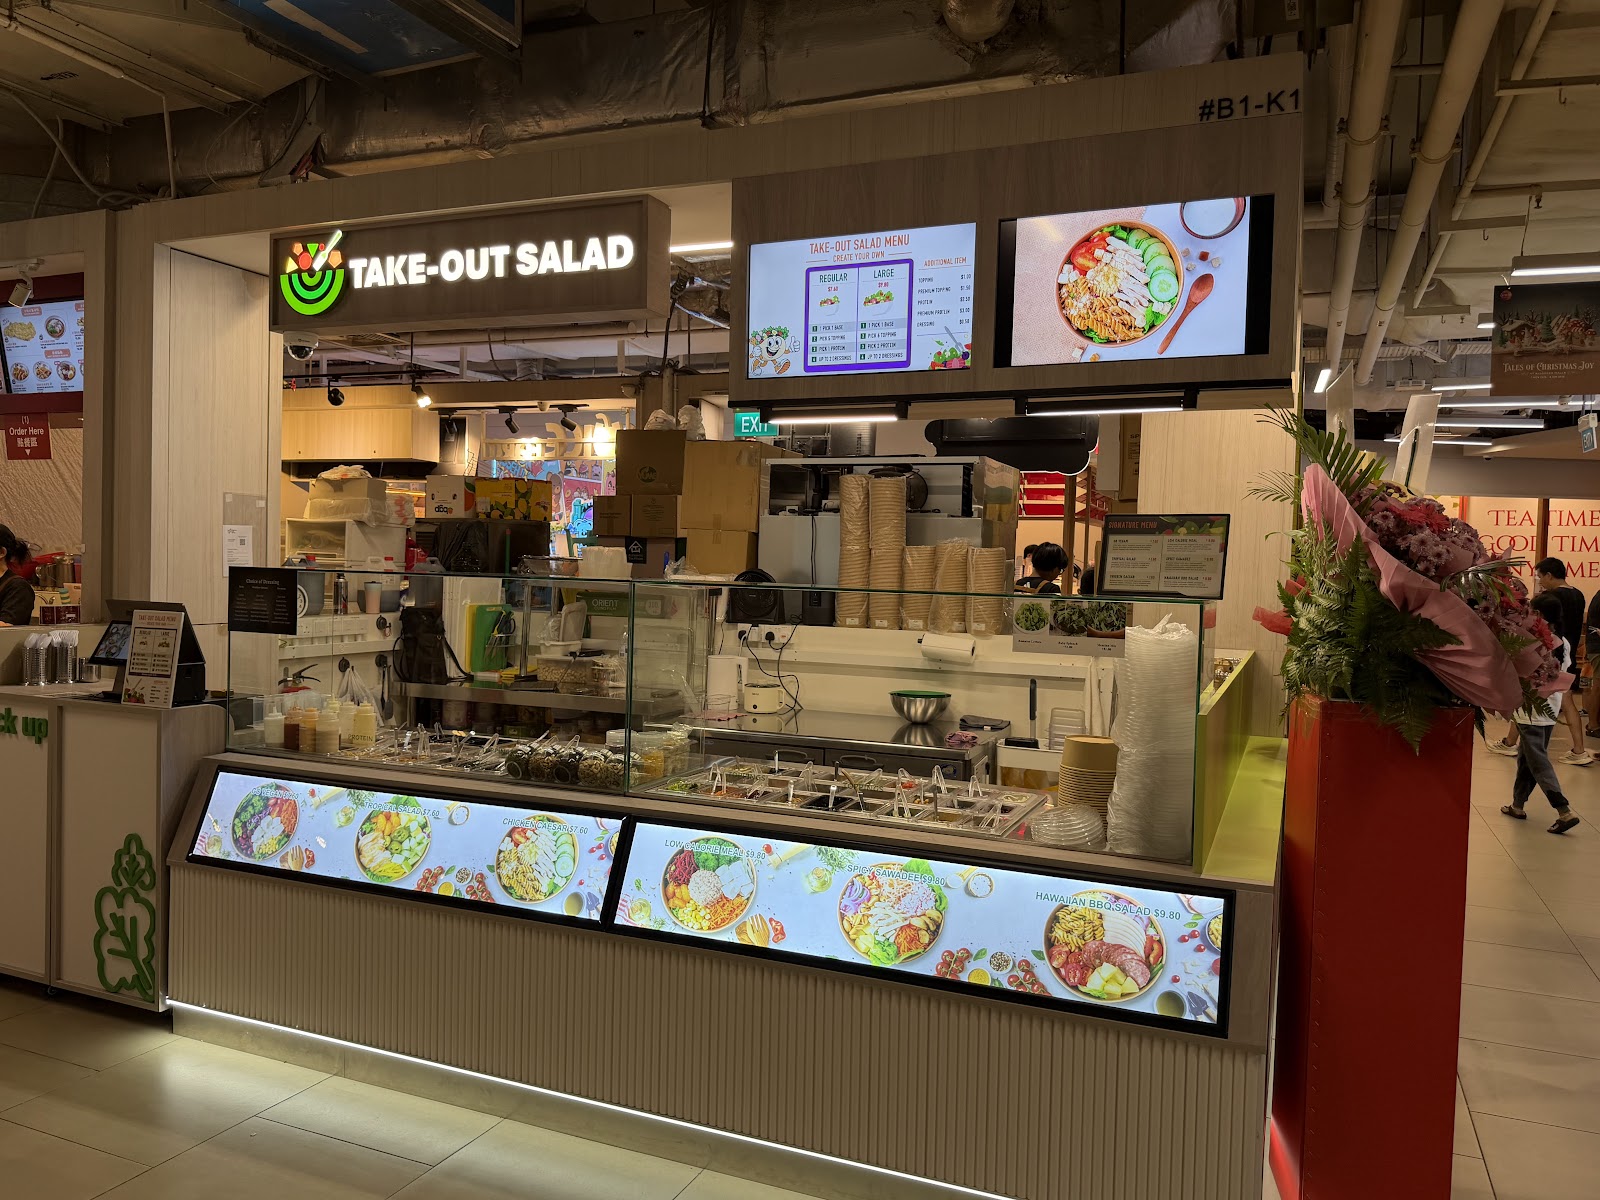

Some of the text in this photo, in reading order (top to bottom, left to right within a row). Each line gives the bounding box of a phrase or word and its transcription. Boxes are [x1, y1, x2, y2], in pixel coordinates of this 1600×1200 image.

[1198, 88, 1299, 122] #B1-K1
[810, 234, 910, 254] TAKE-OUT SALAD MENU
[348, 235, 634, 289] TAKE-OUT SALAD
[832, 250, 885, 262] CREATE YOUR OWN
[924, 256, 967, 267] ADDITIONAL ITEM
[819, 272, 848, 283] REGULAR
[874, 268, 894, 278] LARGE
[1502, 362, 1524, 372] TALES
[1536, 362, 1577, 372] CHRISTMAS
[1578, 360, 1596, 371] JOY
[21, 416, 30, 424] (1)
[9, 426, 44, 435] Order Here
[1488, 510, 1536, 526] TEA
[1479, 534, 1536, 554] GOO
[592, 599, 619, 607] ORIENT
[22, 717, 48, 744] up
[348, 733, 373, 742] PROTEIN
[364, 801, 440, 817] TROPICAL SALAD $7.60
[502, 817, 589, 834] CHICKEN CAESAR $7.60
[664, 839, 766, 861] LOW CALORIE MEAL $9.80
[847, 864, 945, 886] SPICY SAWADEE $9.80
[1035, 891, 1181, 921] HAWAIIAN BBQ SALAD $9.80
